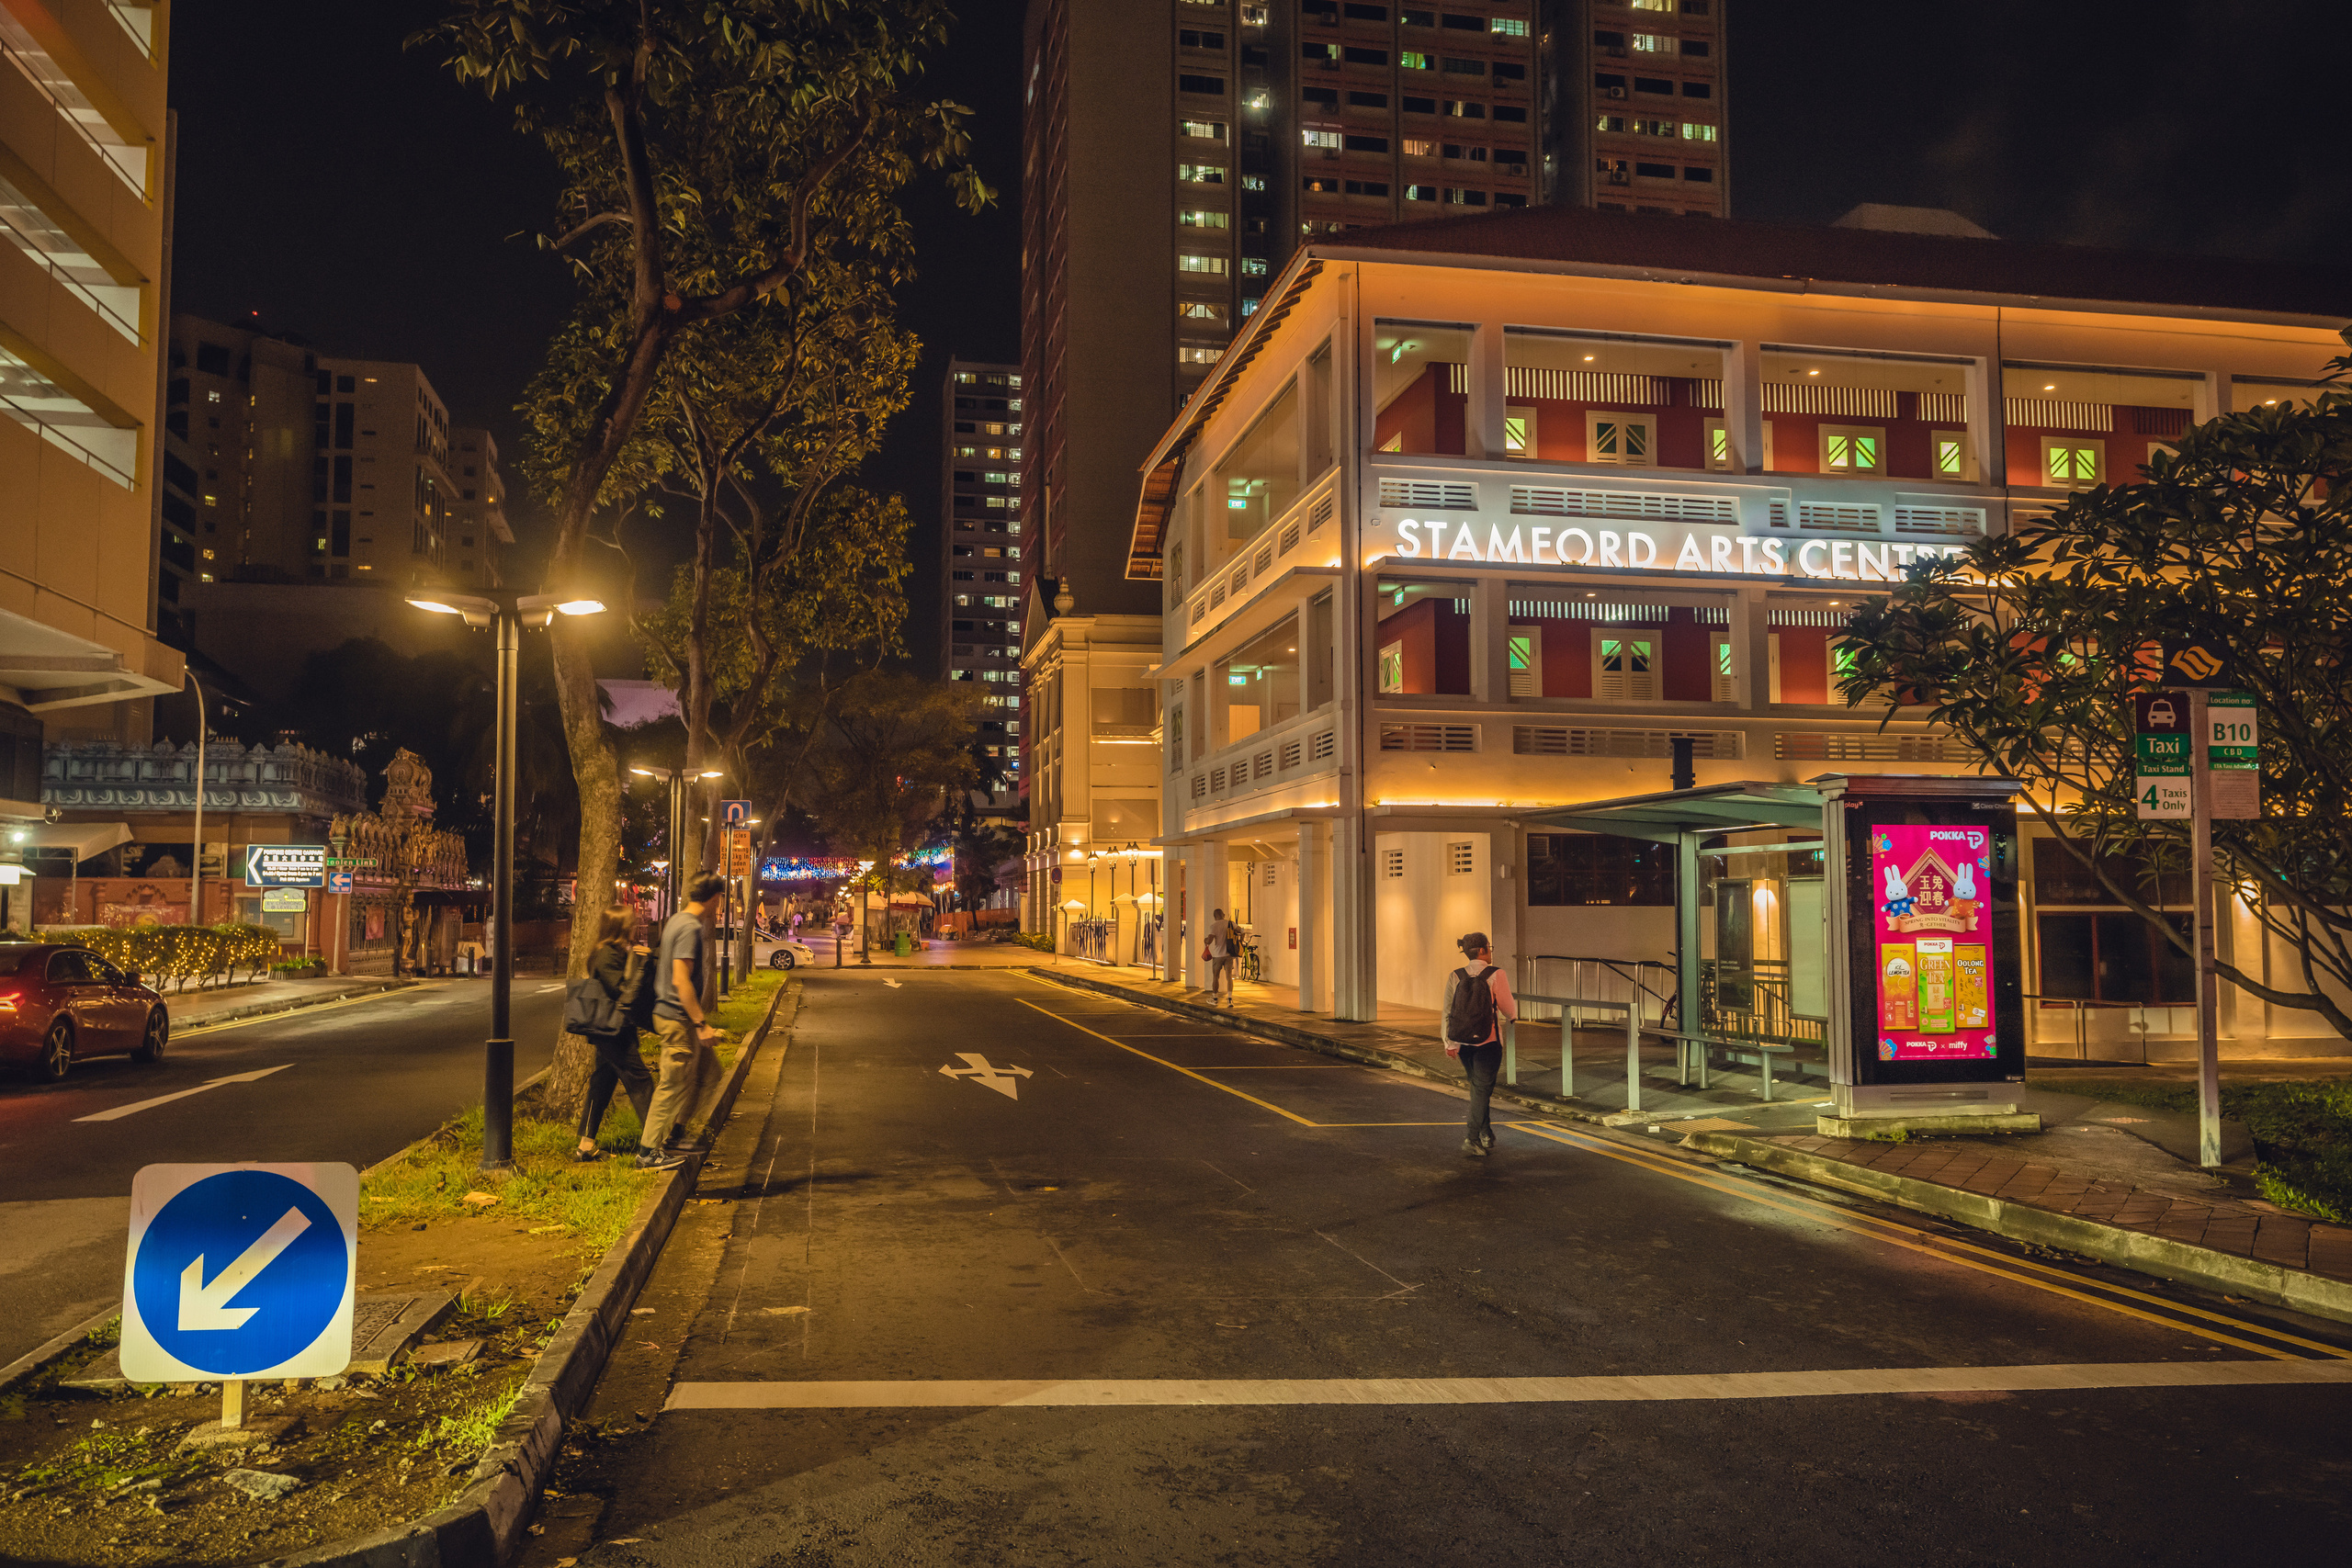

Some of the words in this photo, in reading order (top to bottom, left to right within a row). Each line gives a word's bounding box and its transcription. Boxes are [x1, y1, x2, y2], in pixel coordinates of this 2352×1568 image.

[1396, 519, 1657, 568] STAMFORD
[1674, 533, 1784, 575] ARTS
[1798, 539, 1964, 581] CENT
[2210, 696, 2240, 705] Location
[2213, 723, 2251, 741] B10
[2146, 738, 2179, 753] Taxi
[2143, 764, 2160, 773] Taxi
[2161, 764, 2185, 773] Stand
[2141, 784, 2160, 811] 4
[2162, 788, 2188, 798] Taxis
[2162, 800, 2186, 812] Only
[1930, 831, 1966, 840] POKKA
[1919, 874, 1944, 890] 玉兔
[1919, 891, 1945, 906] 迎春
[1919, 958, 1951, 970] GREEN
[1957, 959, 1984, 967] OOLONG
[1963, 966, 1977, 976] TEA
[1949, 1041, 1968, 1051] miffy
